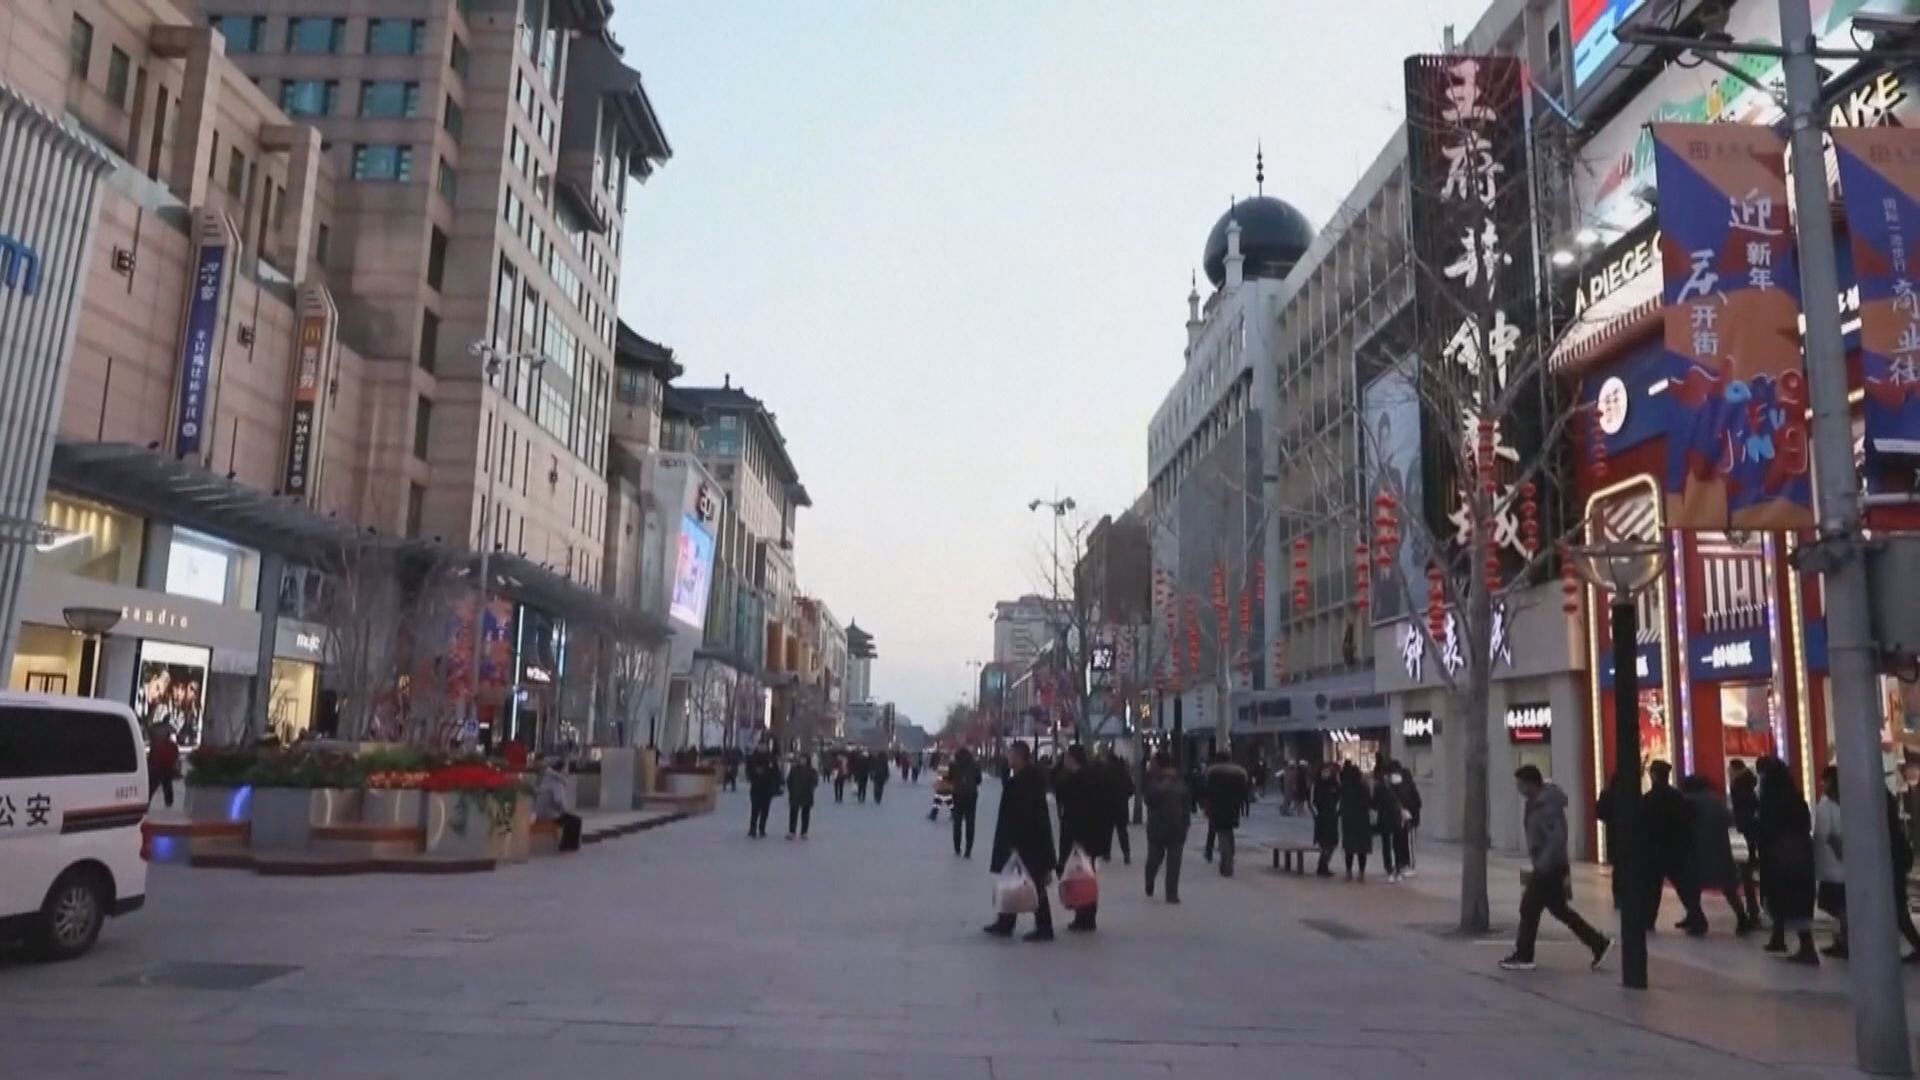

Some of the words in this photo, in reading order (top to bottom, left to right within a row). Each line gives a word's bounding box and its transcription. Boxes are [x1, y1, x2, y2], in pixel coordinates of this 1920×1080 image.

[1729, 187, 1783, 292] 迎新年
[1589, 243, 1651, 299] PIECE
[120, 604, 189, 629] sandro
[0, 793, 52, 828] 公安
